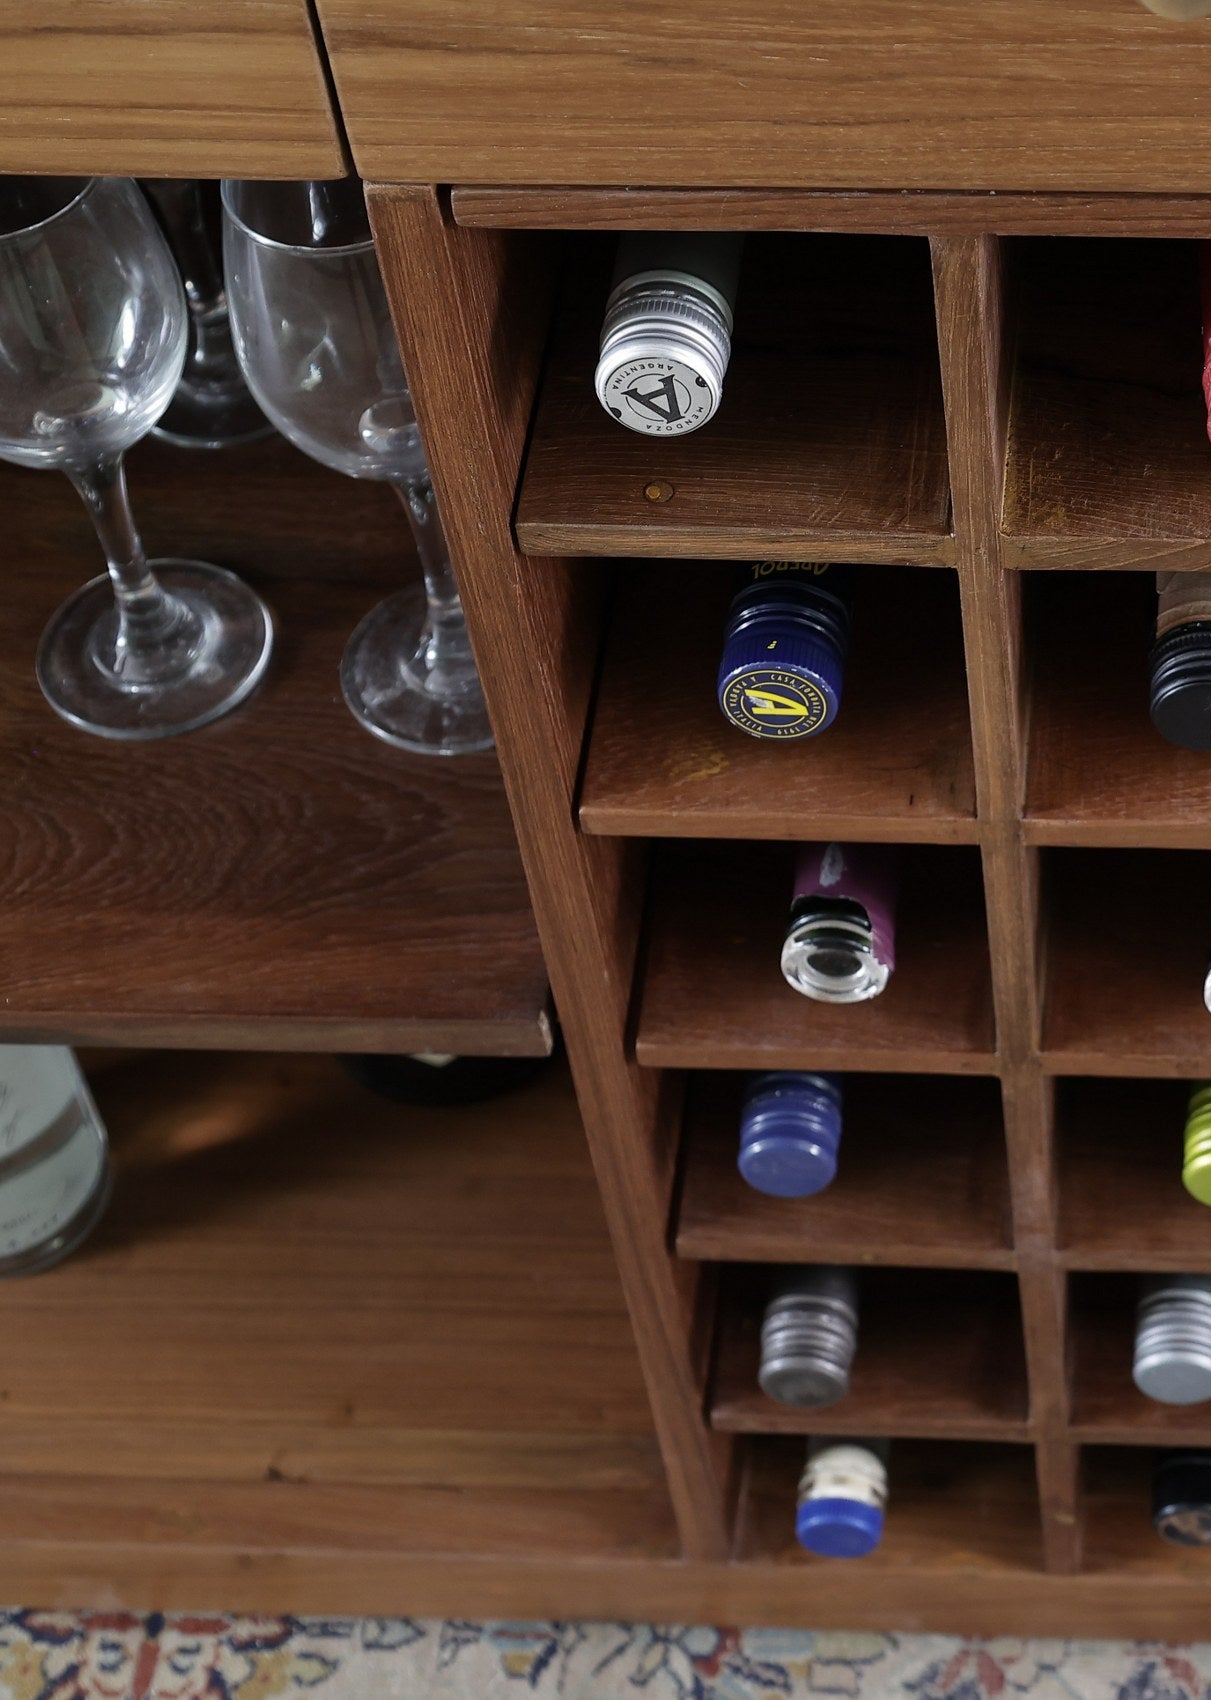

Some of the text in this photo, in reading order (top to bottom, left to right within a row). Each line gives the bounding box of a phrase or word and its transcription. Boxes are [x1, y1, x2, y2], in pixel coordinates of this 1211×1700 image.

[612, 362, 674, 390] ARGENTINA
[620, 374, 685, 424] A
[646, 407, 704, 431] MENDOZA
[770, 673, 796, 686] CASA
[733, 710, 763, 732] ITALIA
